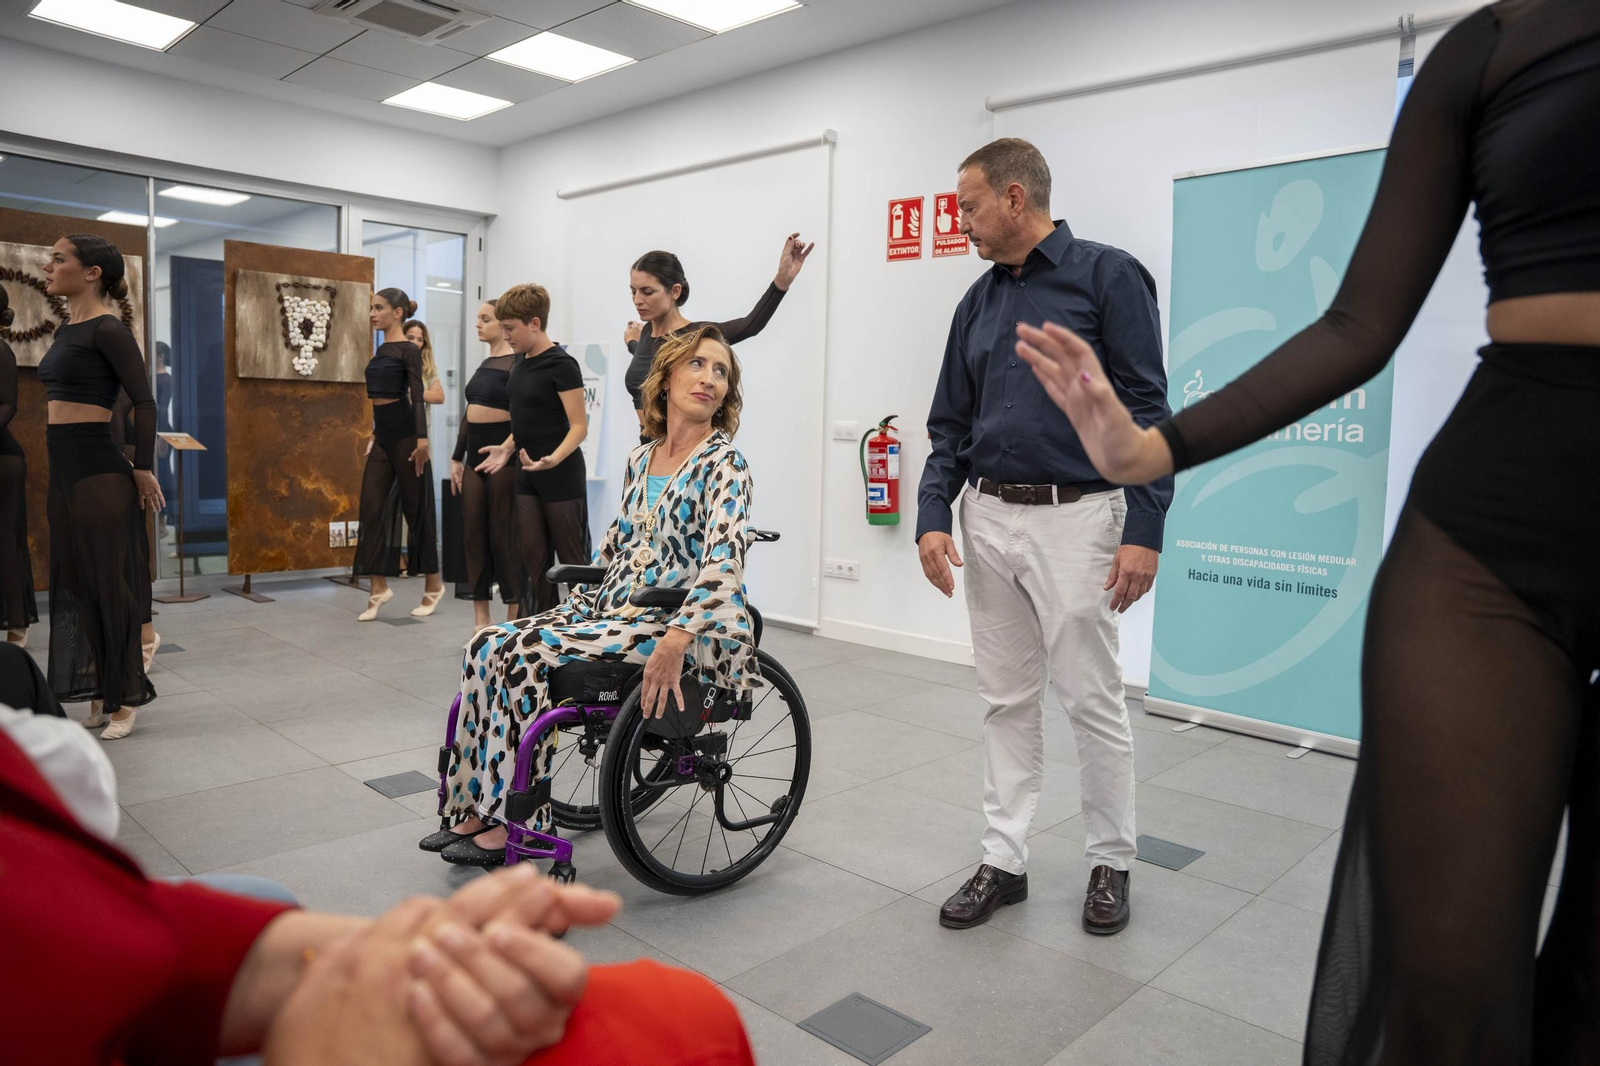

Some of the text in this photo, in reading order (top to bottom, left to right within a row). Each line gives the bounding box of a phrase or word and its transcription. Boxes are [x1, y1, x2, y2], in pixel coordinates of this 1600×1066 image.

[889, 245, 920, 256] EXTINTOR
[936, 238, 966, 246] PULSADOR
[943, 246, 967, 254] ALARMA
[1267, 417, 1364, 443] mería
[1176, 539, 1357, 567] ASOCIACIÓN DE PERSONAS CON LESIÓN MEDULAR
[1201, 554, 1328, 576] Y OTRAS DISCAPACIDADES FÍSICAS
[1188, 568, 1338, 599] Hacia una vida sin límites
